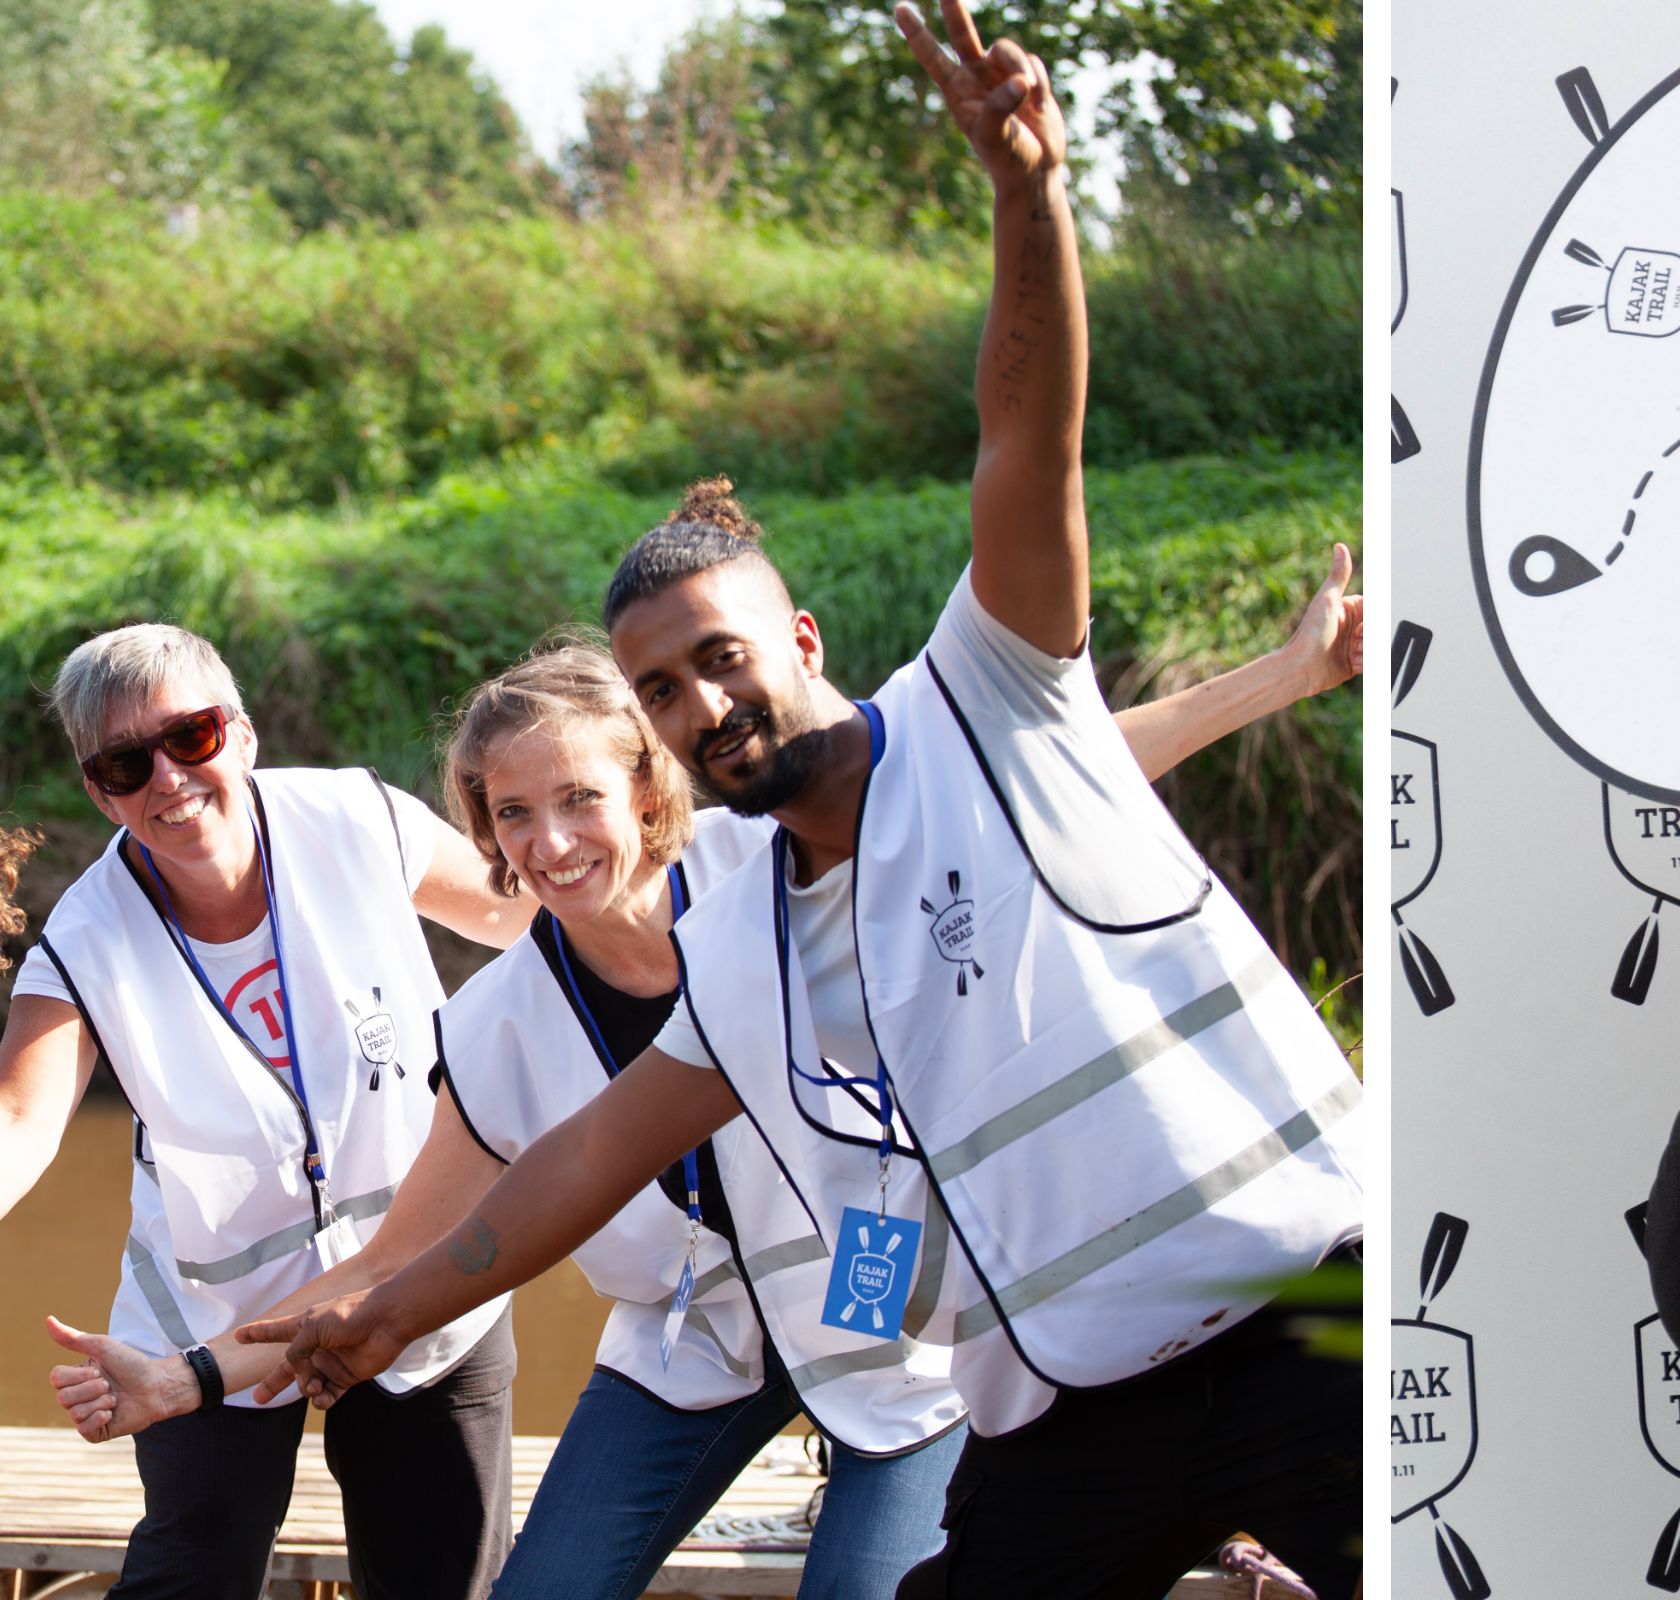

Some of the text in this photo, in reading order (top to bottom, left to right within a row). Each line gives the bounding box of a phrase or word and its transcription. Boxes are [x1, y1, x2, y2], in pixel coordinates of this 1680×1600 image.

[1625, 260, 1651, 323] KAJAK
[1646, 267, 1672, 322] TRAIL
[939, 911, 973, 940] KAJAK
[944, 926, 974, 948] TRAIL
[362, 1024, 391, 1042] KAJAK
[367, 1035, 392, 1051] TRAIL
[856, 1263, 889, 1278] KAJAK
[856, 1274, 884, 1288] TRAIL
